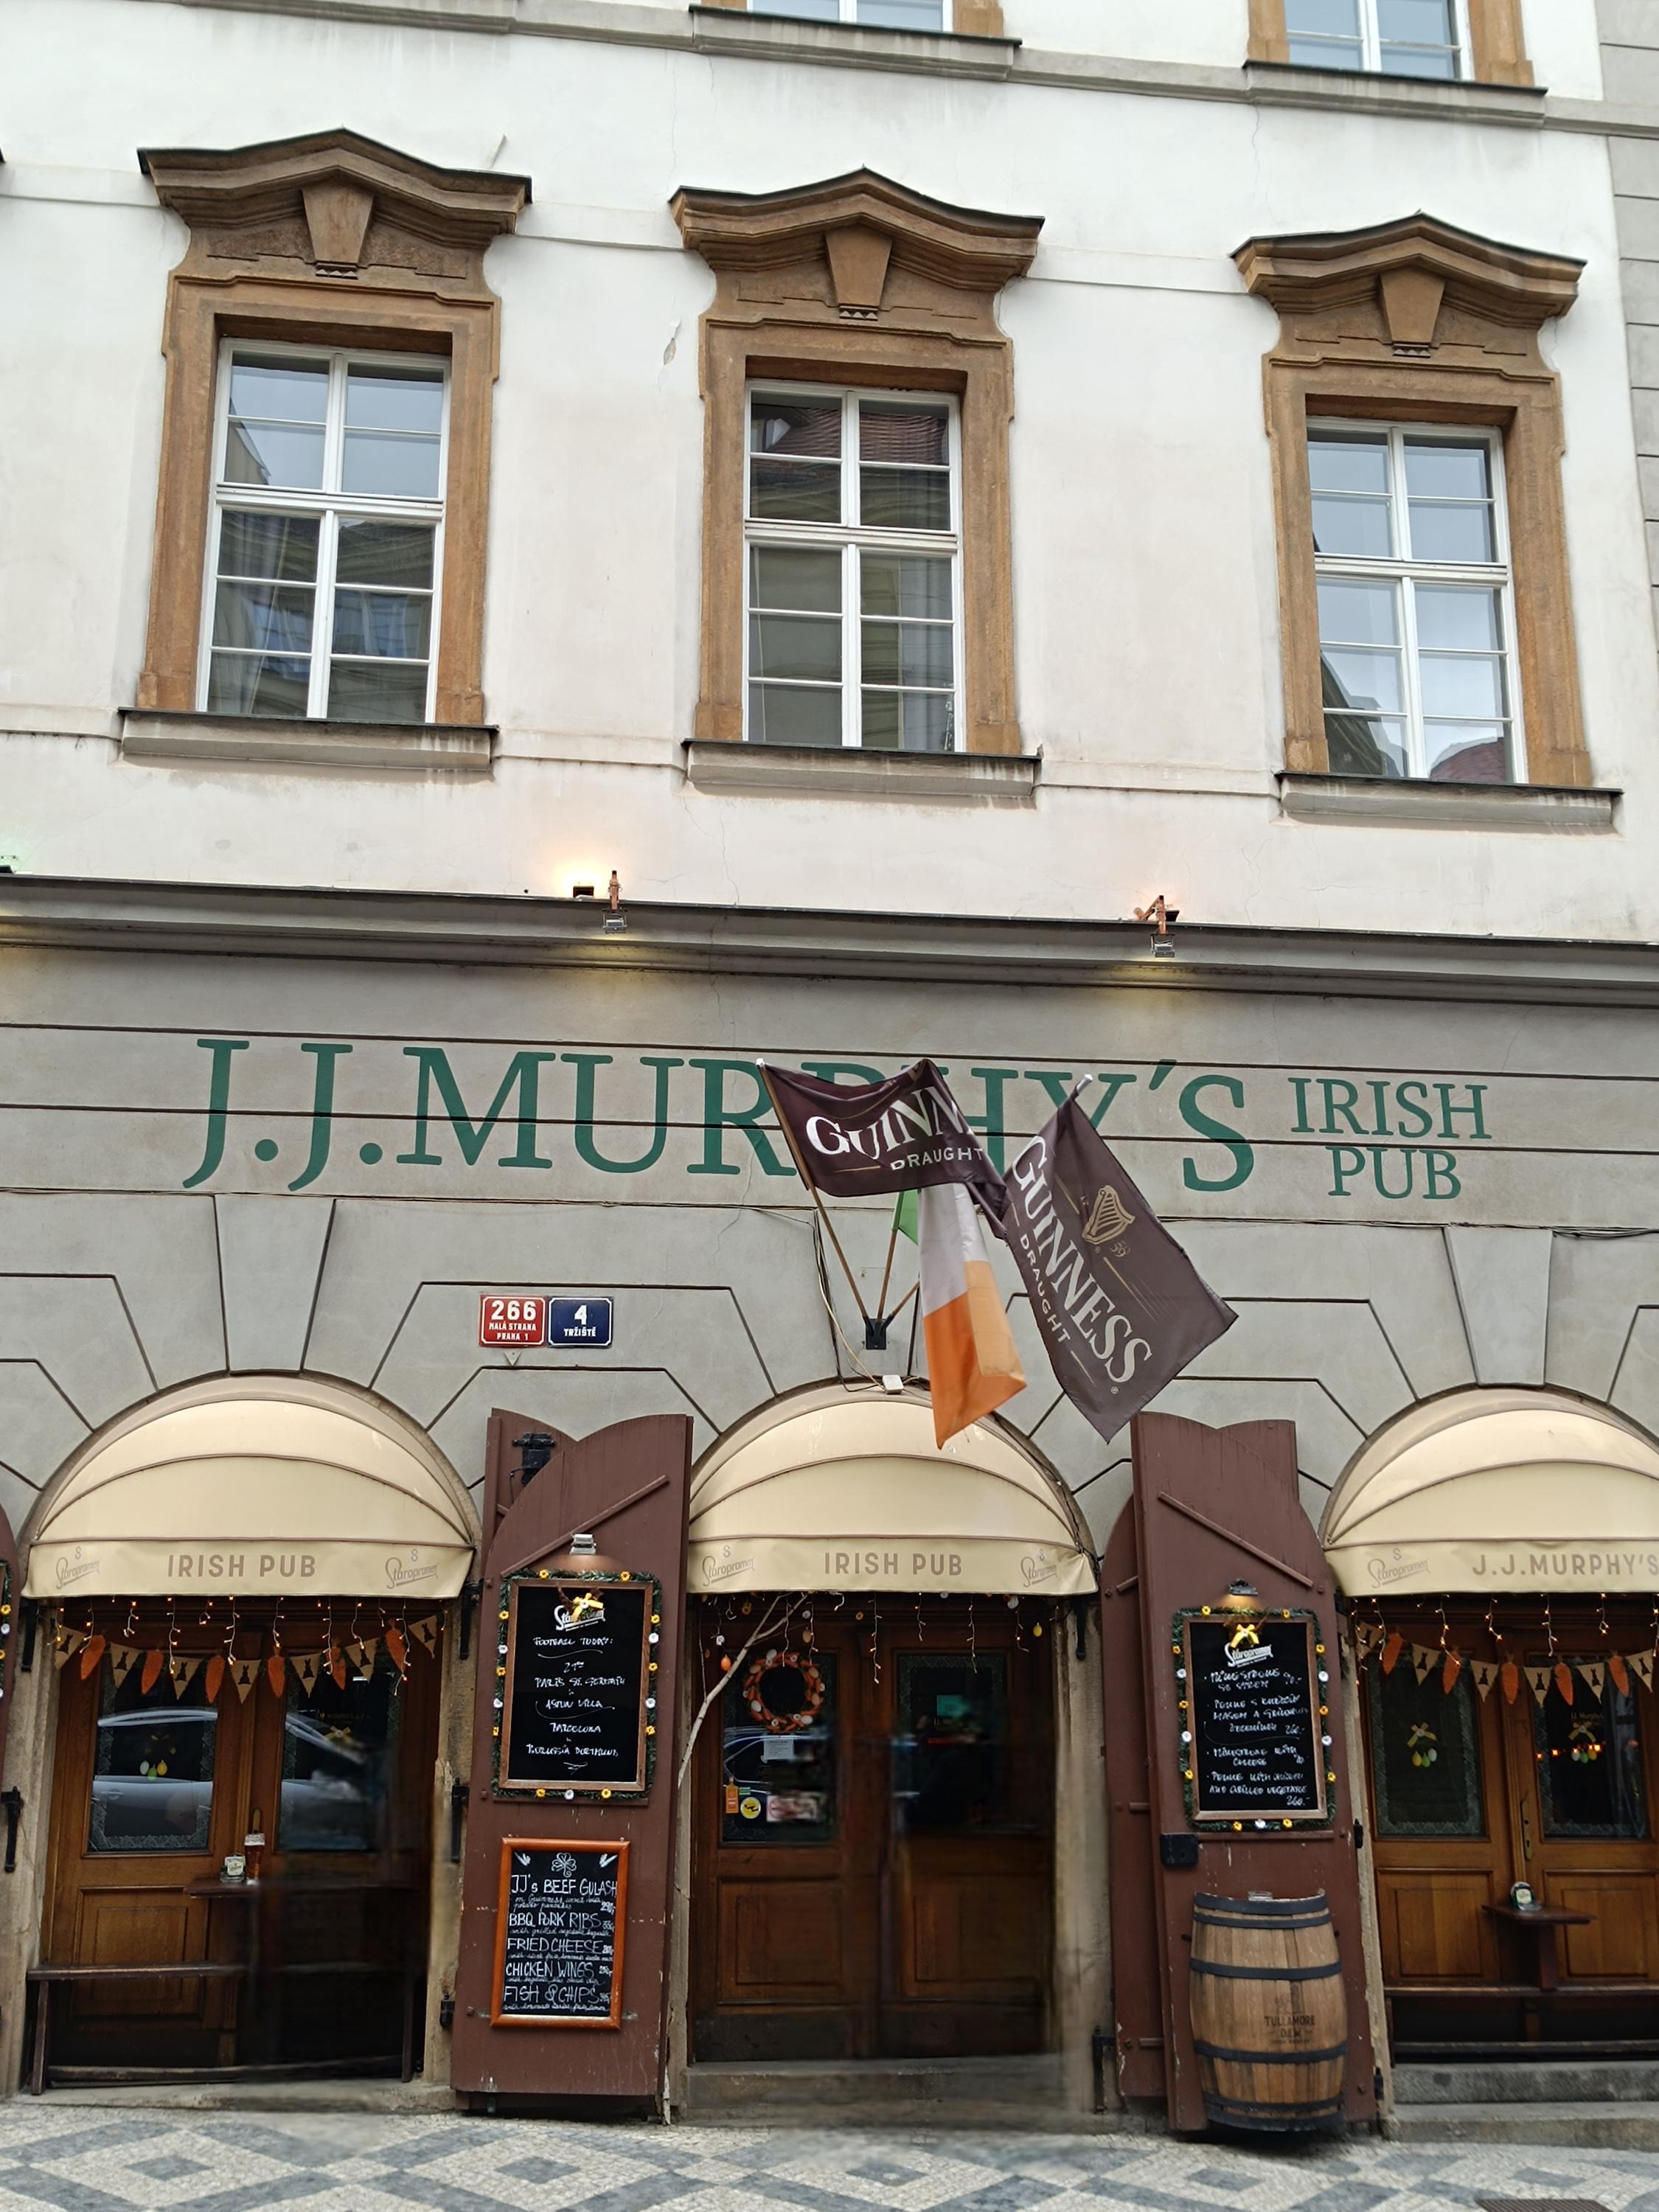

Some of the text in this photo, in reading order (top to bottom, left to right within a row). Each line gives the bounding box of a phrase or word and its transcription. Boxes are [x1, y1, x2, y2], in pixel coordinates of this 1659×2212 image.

[1287, 1077, 1492, 1139] IRISH
[890, 1147, 983, 1171] DRAUGHT
[1326, 1145, 1461, 1200] PUB
[1012, 1135, 1152, 1383] GUINNESS
[1020, 1234, 1071, 1343] DRAUGHT
[491, 1300, 536, 1321] 266
[574, 1304, 588, 1325] 4
[489, 1321, 507, 1330] MALÁ
[563, 1327, 597, 1337] TRŽIŠTĚ
[497, 1332, 520, 1340] PRAHA
[168, 1554, 316, 1578] IRISH PUB
[702, 1556, 755, 1587] Staropramen
[824, 1552, 962, 1576] IRISH PUB
[1472, 1554, 1659, 1576] J.J.MURPHY'S
[56, 1557, 101, 1590] Staropramen
[385, 1557, 439, 1590] Staropramen
[1367, 1558, 1430, 1589] Staropramen
[533, 1636, 575, 1646] FOOTBALL
[535, 1677, 564, 1688] PARIS
[585, 1676, 625, 1687] GERMAIN
[546, 1698, 603, 1709] ASTON VILLA
[1253, 1710, 1259, 1718] A
[549, 1722, 601, 1733] BARCELONA
[526, 1744, 619, 1756] BORUSSIA DORTMUND
[1209, 1784, 1227, 1793] AND
[543, 1879, 576, 1894] BEEF
[580, 1878, 617, 1896] GULASH
[509, 1912, 535, 1927] BBQ
[569, 1912, 602, 1930] RIBS
[507, 1938, 549, 1952] FRIED
[551, 1938, 603, 1954] CHEESE
[506, 1961, 553, 1977] CHICKEN
[557, 1961, 594, 1978] WINGS
[504, 1985, 539, 2003] FISH
[558, 1986, 599, 2003] CHIPS
[1264, 2014, 1315, 2027] TULLAMORE
